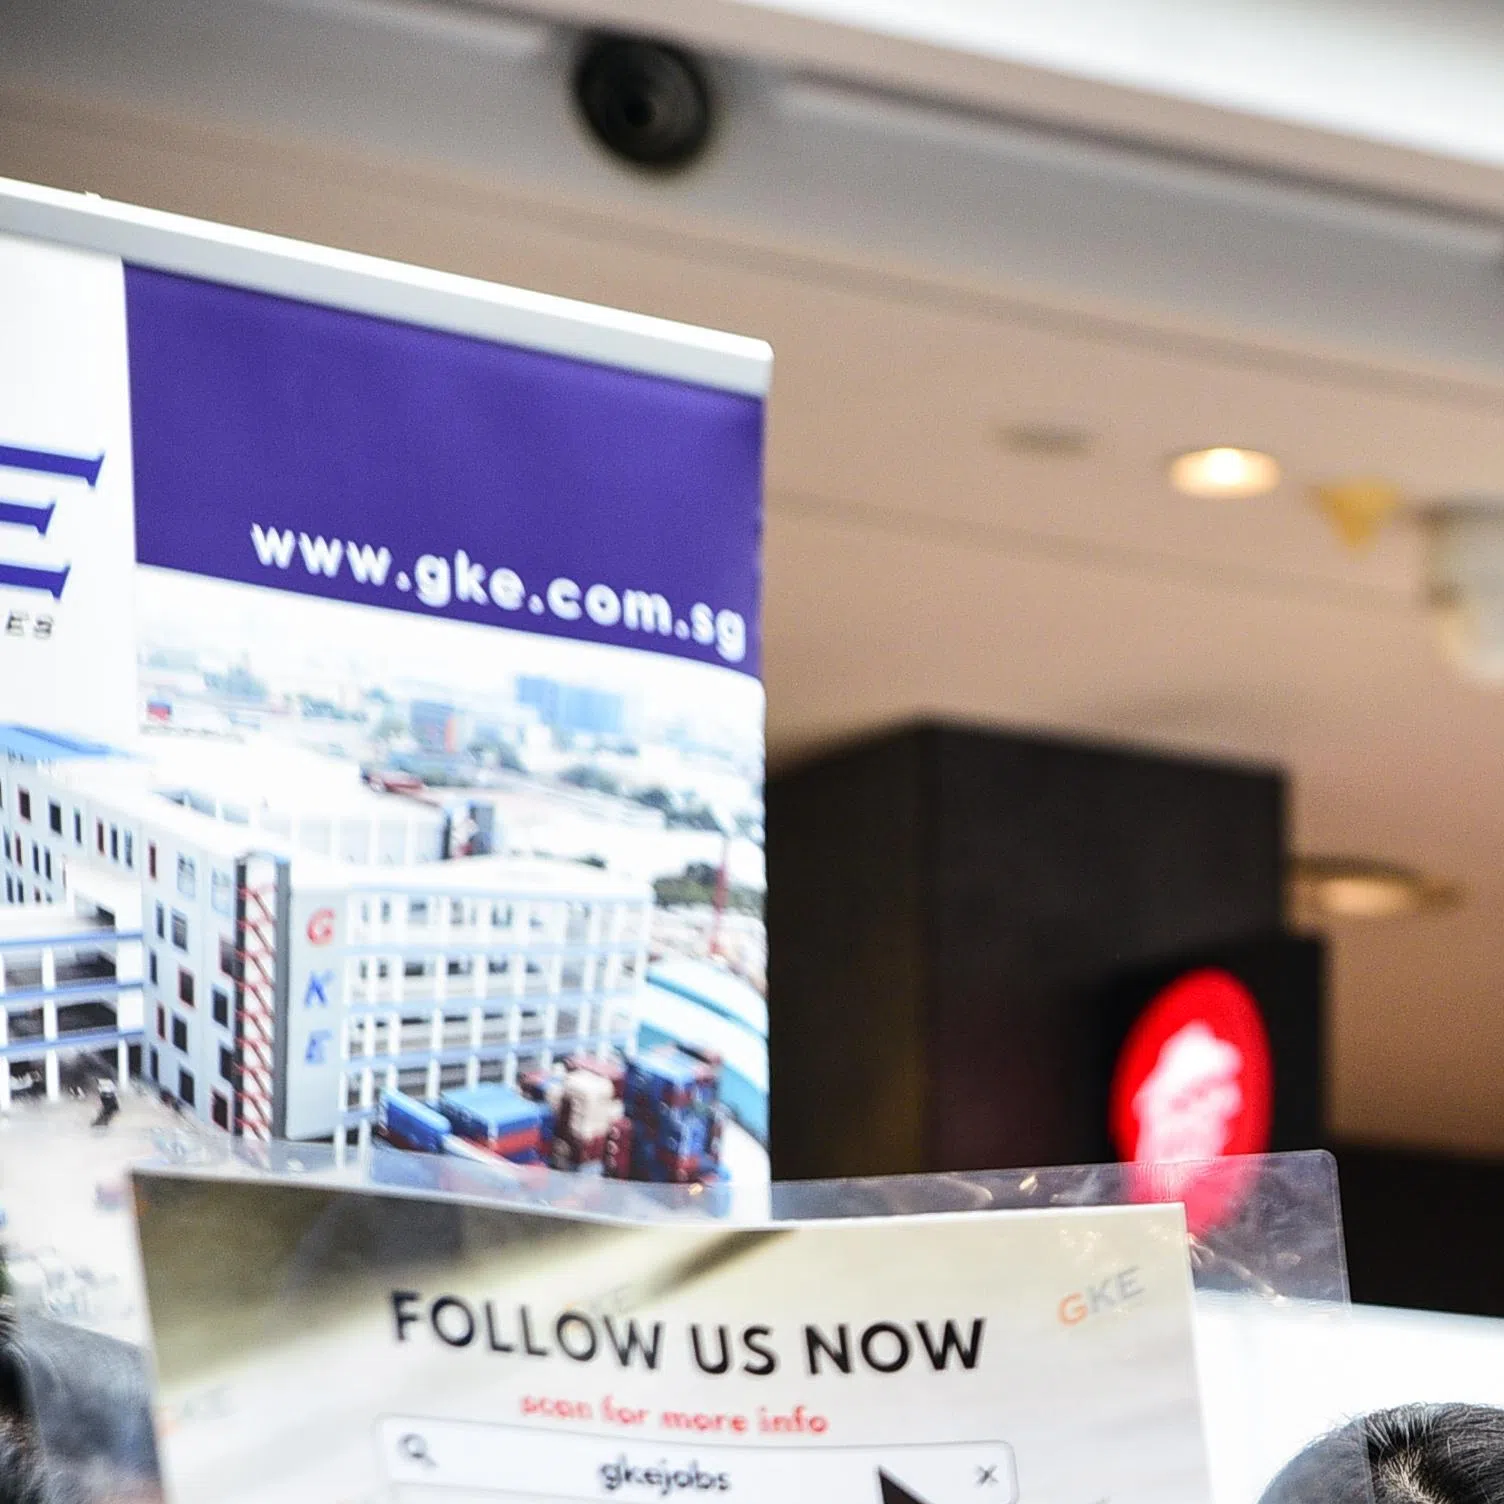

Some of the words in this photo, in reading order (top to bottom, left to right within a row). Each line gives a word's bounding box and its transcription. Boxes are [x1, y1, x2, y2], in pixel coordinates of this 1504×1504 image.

[250, 523, 747, 662] www.gke.com.sg
[1055, 1264, 1147, 1328] GKE
[388, 1289, 665, 1371] FOLLOW
[687, 1320, 779, 1377] US
[803, 1316, 986, 1377] NOW
[521, 1394, 593, 1422] scan
[600, 1395, 649, 1427] for
[661, 1406, 748, 1434] more
[760, 1406, 829, 1437] info
[597, 1456, 732, 1499] gkejobs
